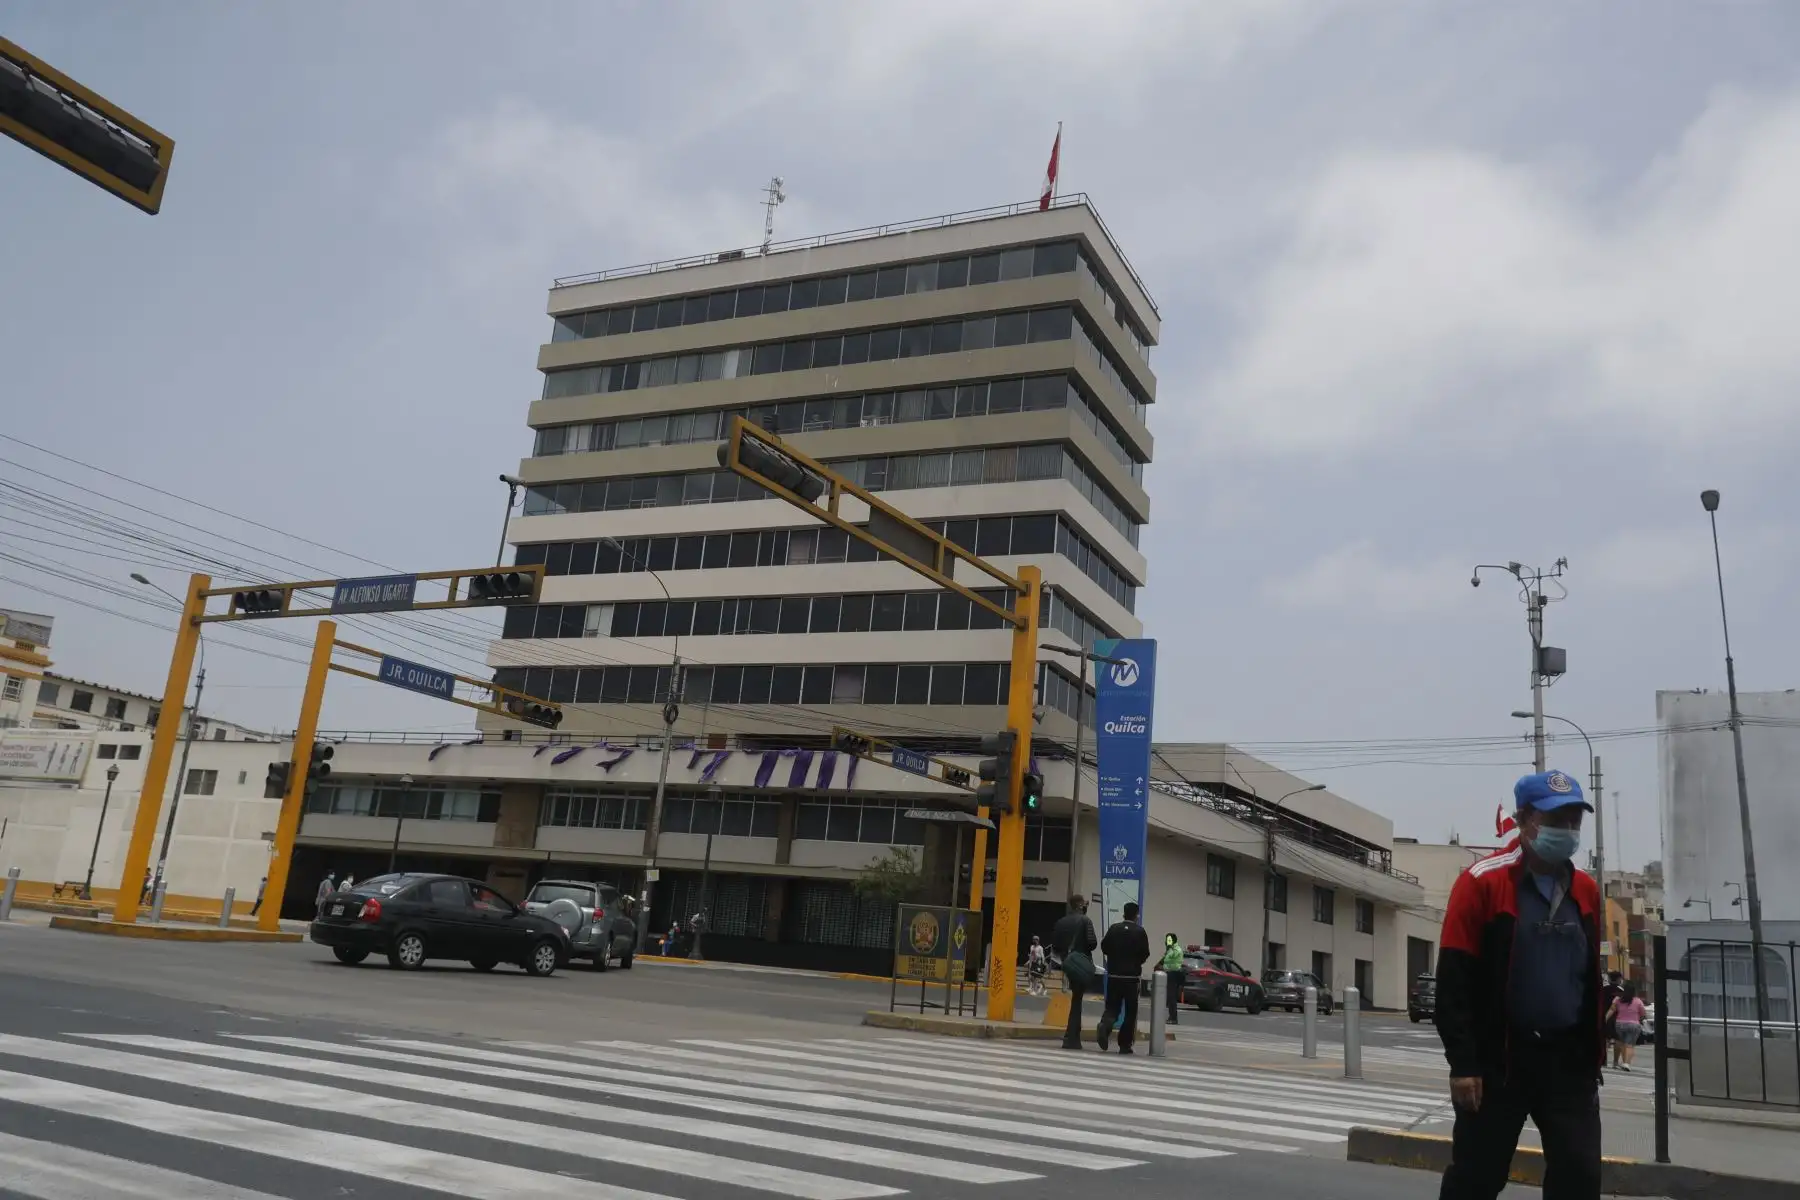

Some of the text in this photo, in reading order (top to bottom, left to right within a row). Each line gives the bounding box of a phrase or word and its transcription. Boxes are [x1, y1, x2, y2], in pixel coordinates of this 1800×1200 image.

[350, 584, 381, 604] ALFONSO
[383, 583, 411, 602] UGARTE
[386, 662, 448, 692] JR. QUILCA
[1104, 721, 1146, 735] Quilca
[906, 755, 926, 771] QUILCA
[1105, 865, 1135, 875] LIMA
